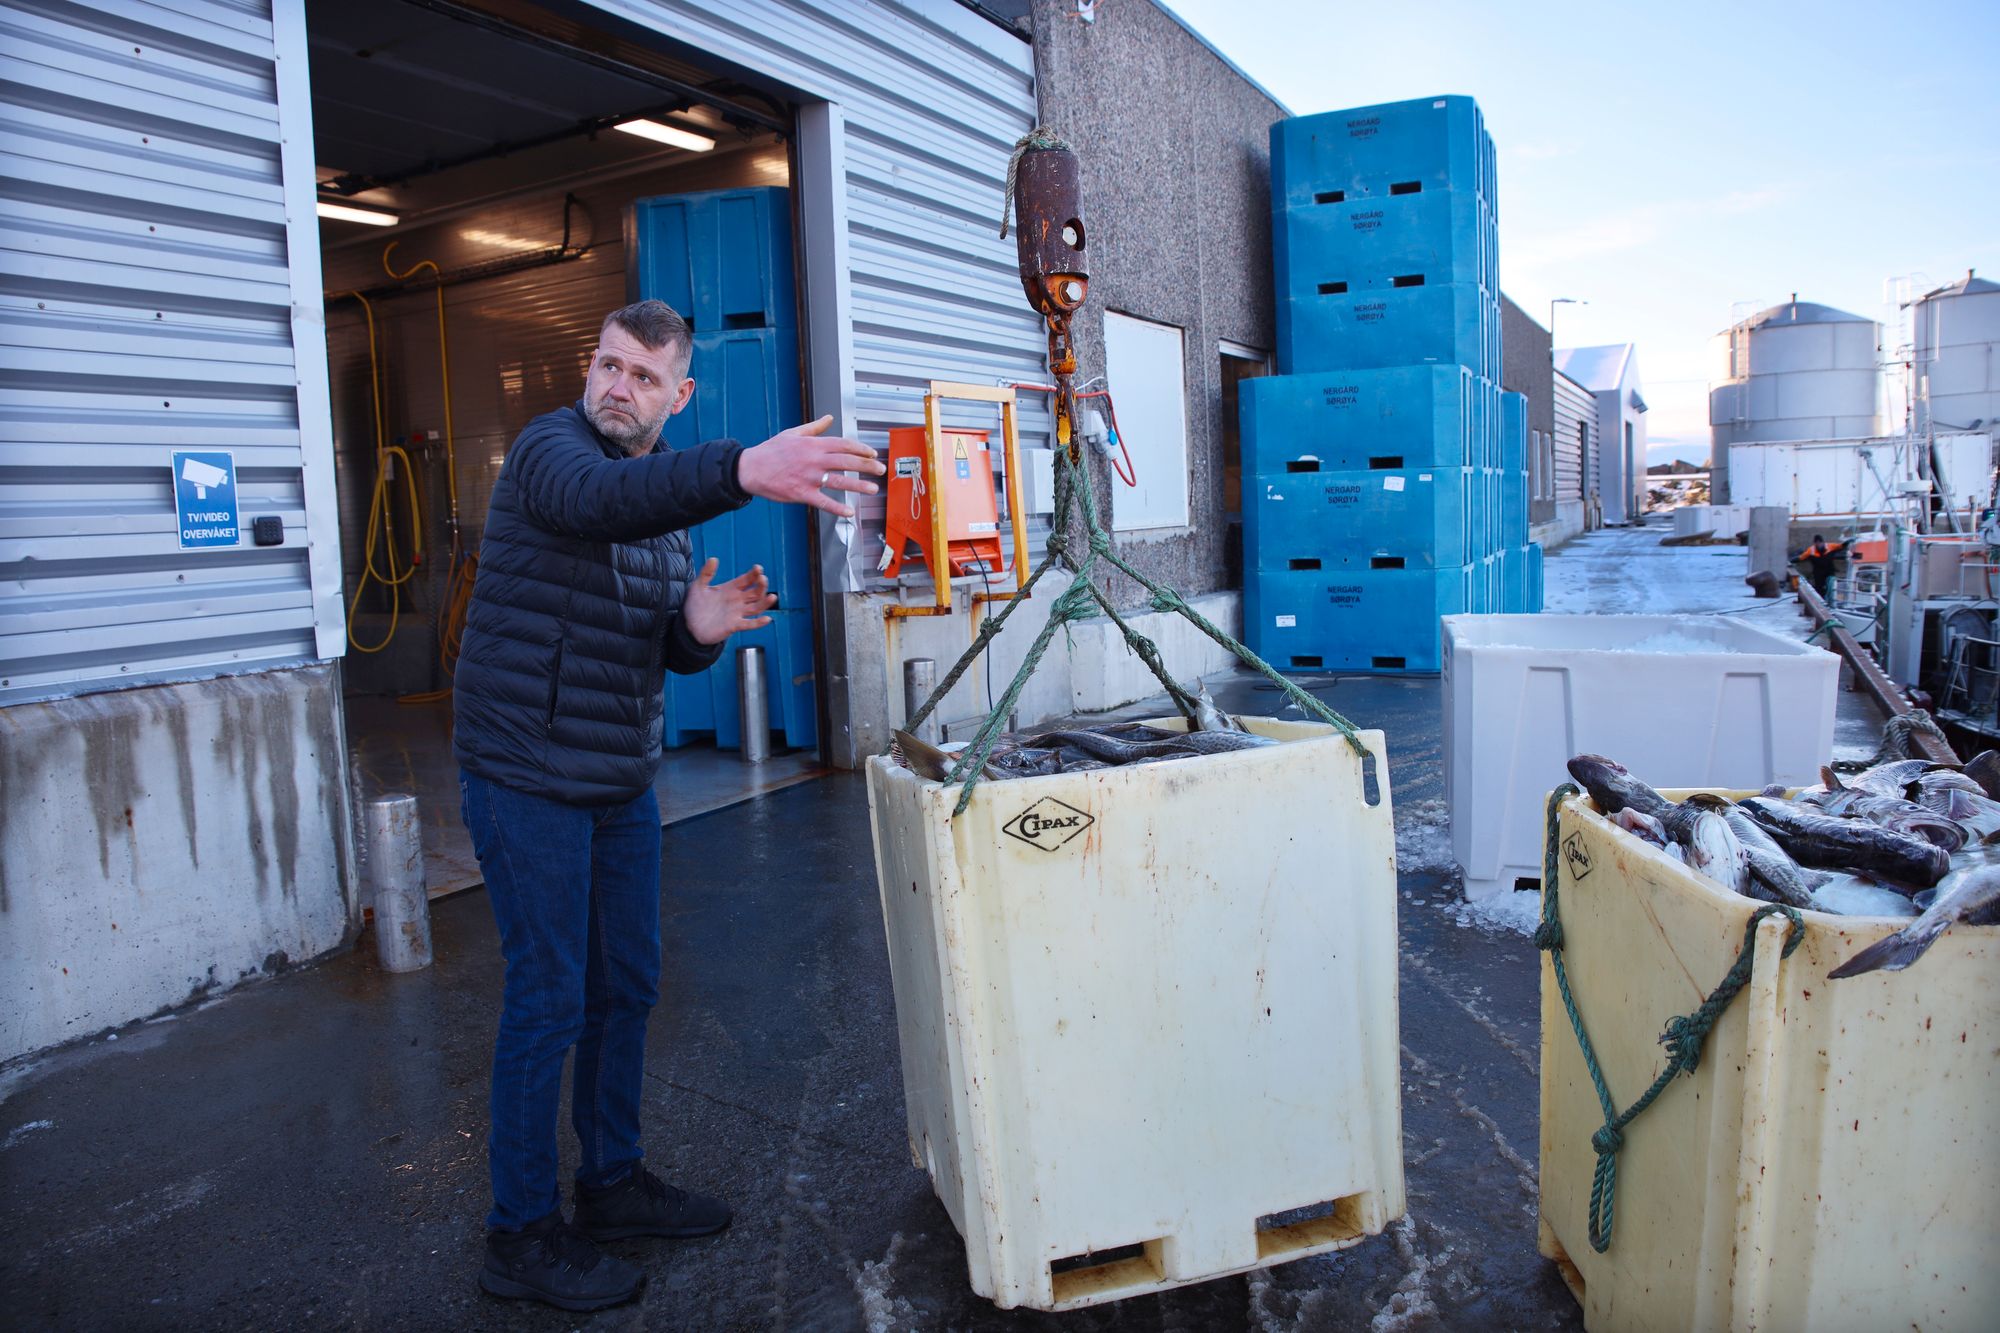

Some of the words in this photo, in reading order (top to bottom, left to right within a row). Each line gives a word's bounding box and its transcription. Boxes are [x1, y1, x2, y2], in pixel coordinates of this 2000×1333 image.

[187, 512, 230, 523] TV/VIDEO
[183, 526, 236, 539] OVERVÅKET
[1019, 813, 1080, 838] CIPAX
